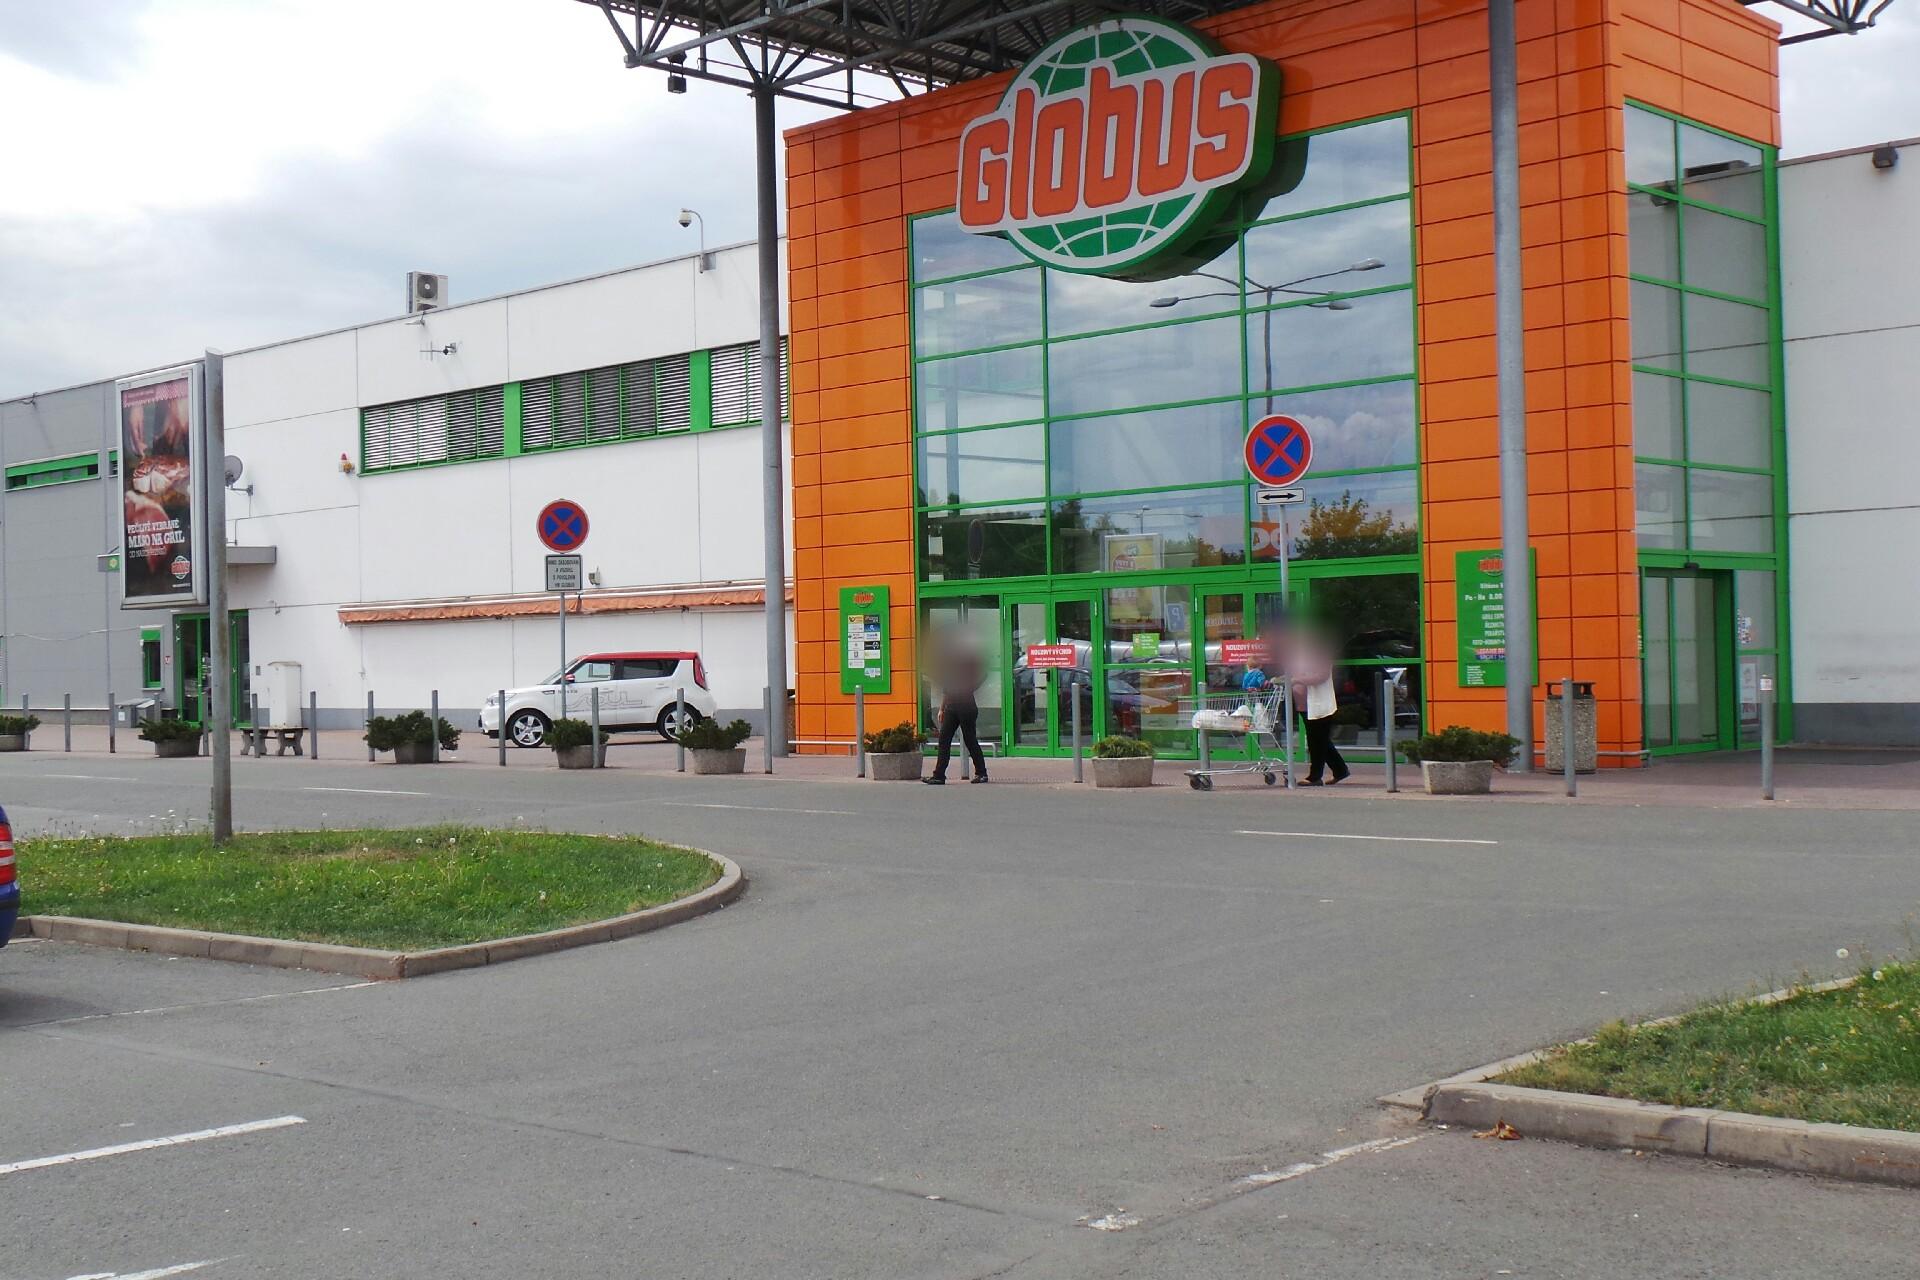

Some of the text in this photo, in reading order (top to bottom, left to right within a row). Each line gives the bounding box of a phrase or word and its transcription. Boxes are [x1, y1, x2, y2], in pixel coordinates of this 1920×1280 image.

[128, 530, 185, 549] MASO NA GRIL
